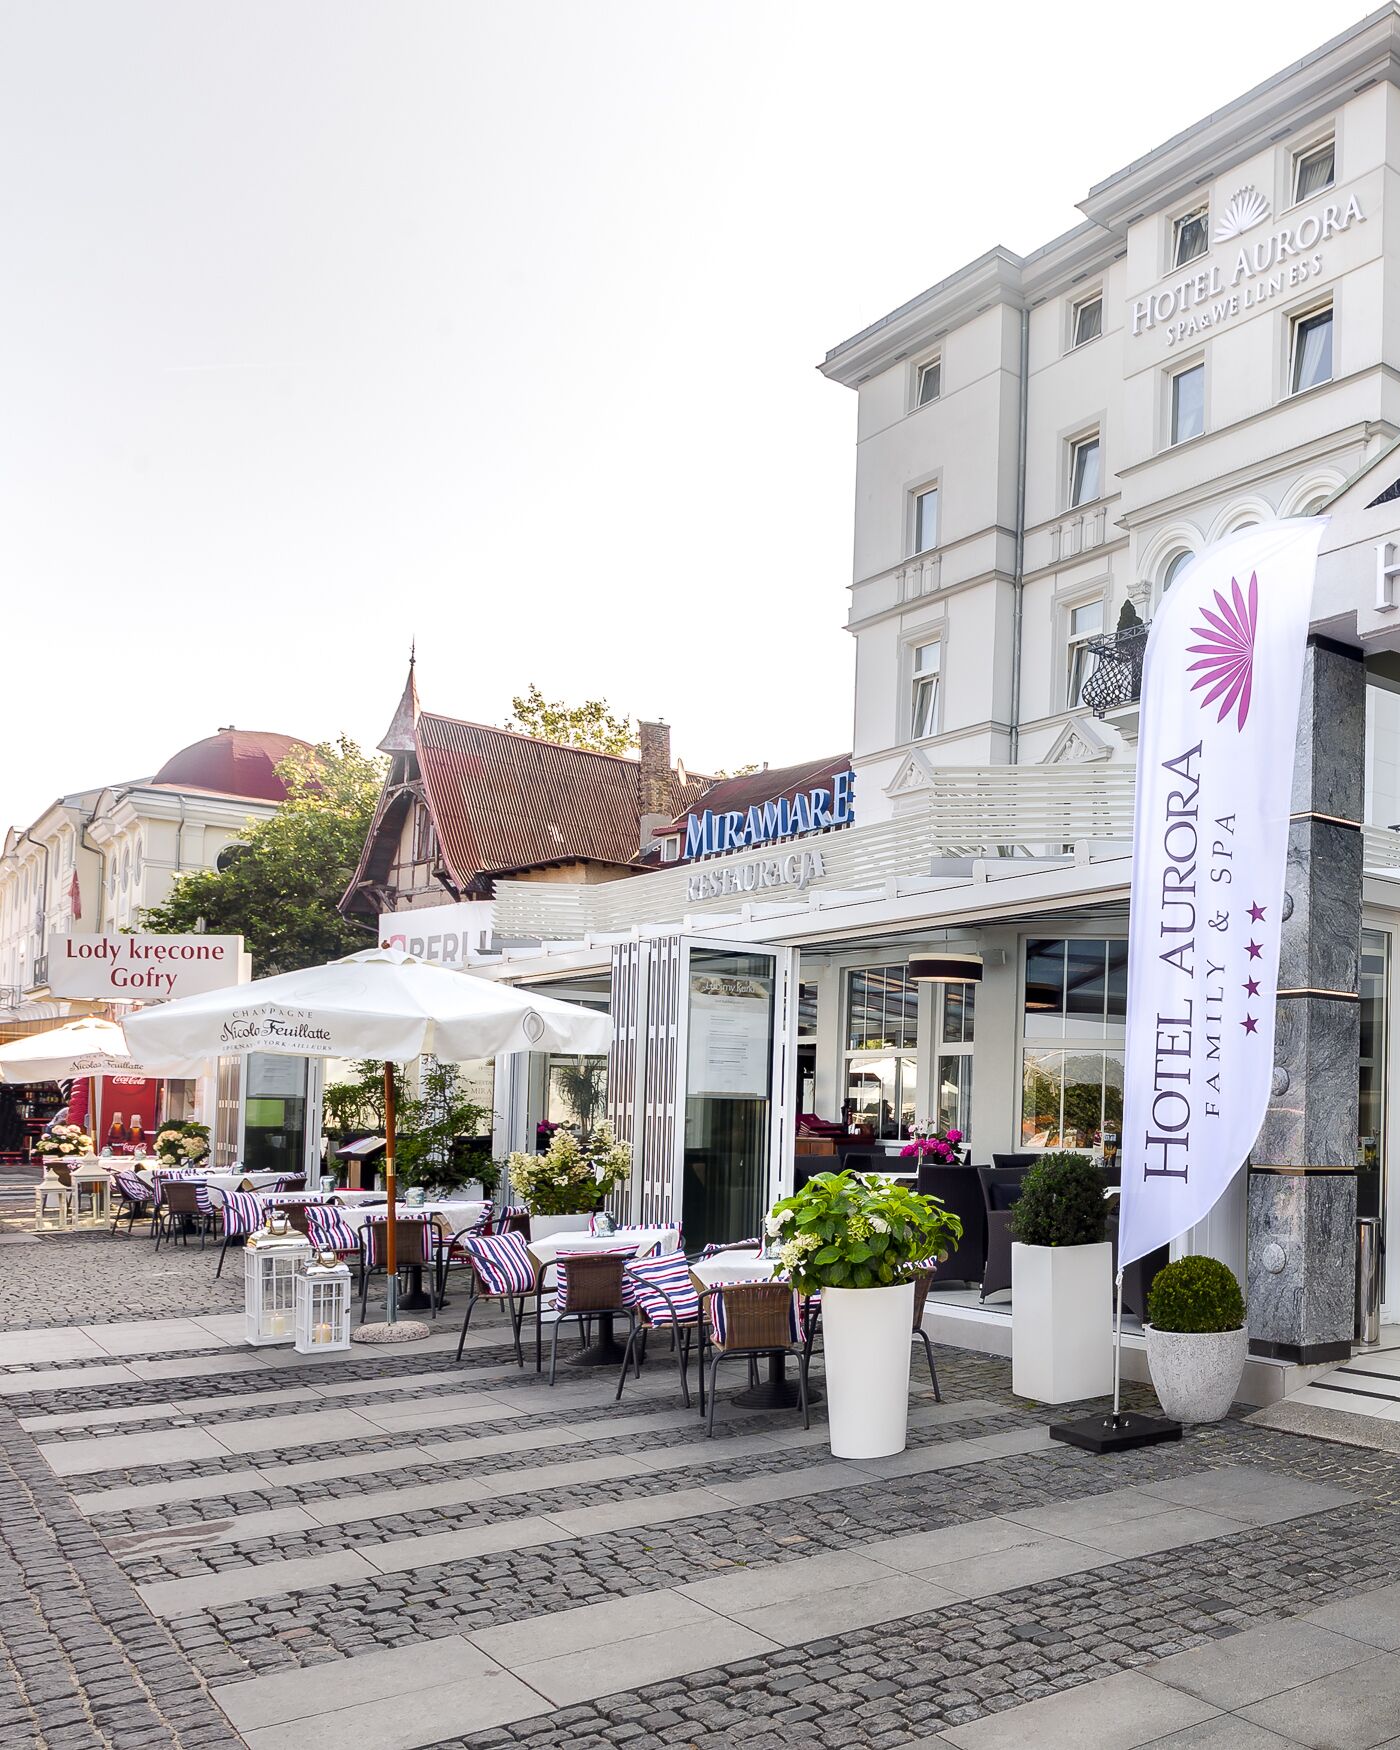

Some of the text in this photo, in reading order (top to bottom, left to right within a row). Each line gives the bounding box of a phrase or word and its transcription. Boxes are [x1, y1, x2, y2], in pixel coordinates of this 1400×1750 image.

[1131, 194, 1367, 337] HOTEL AURORA
[682, 771, 857, 860] MIRAMARE
[687, 850, 827, 901] RESTAURACJA
[66, 938, 225, 965] Lody kręcone
[110, 967, 178, 994] Gofry
[1143, 739, 1203, 1184] HOTEL AURORA
[1205, 812, 1236, 1118] FAMILY & SPA
[220, 1019, 260, 1042] Nicola
